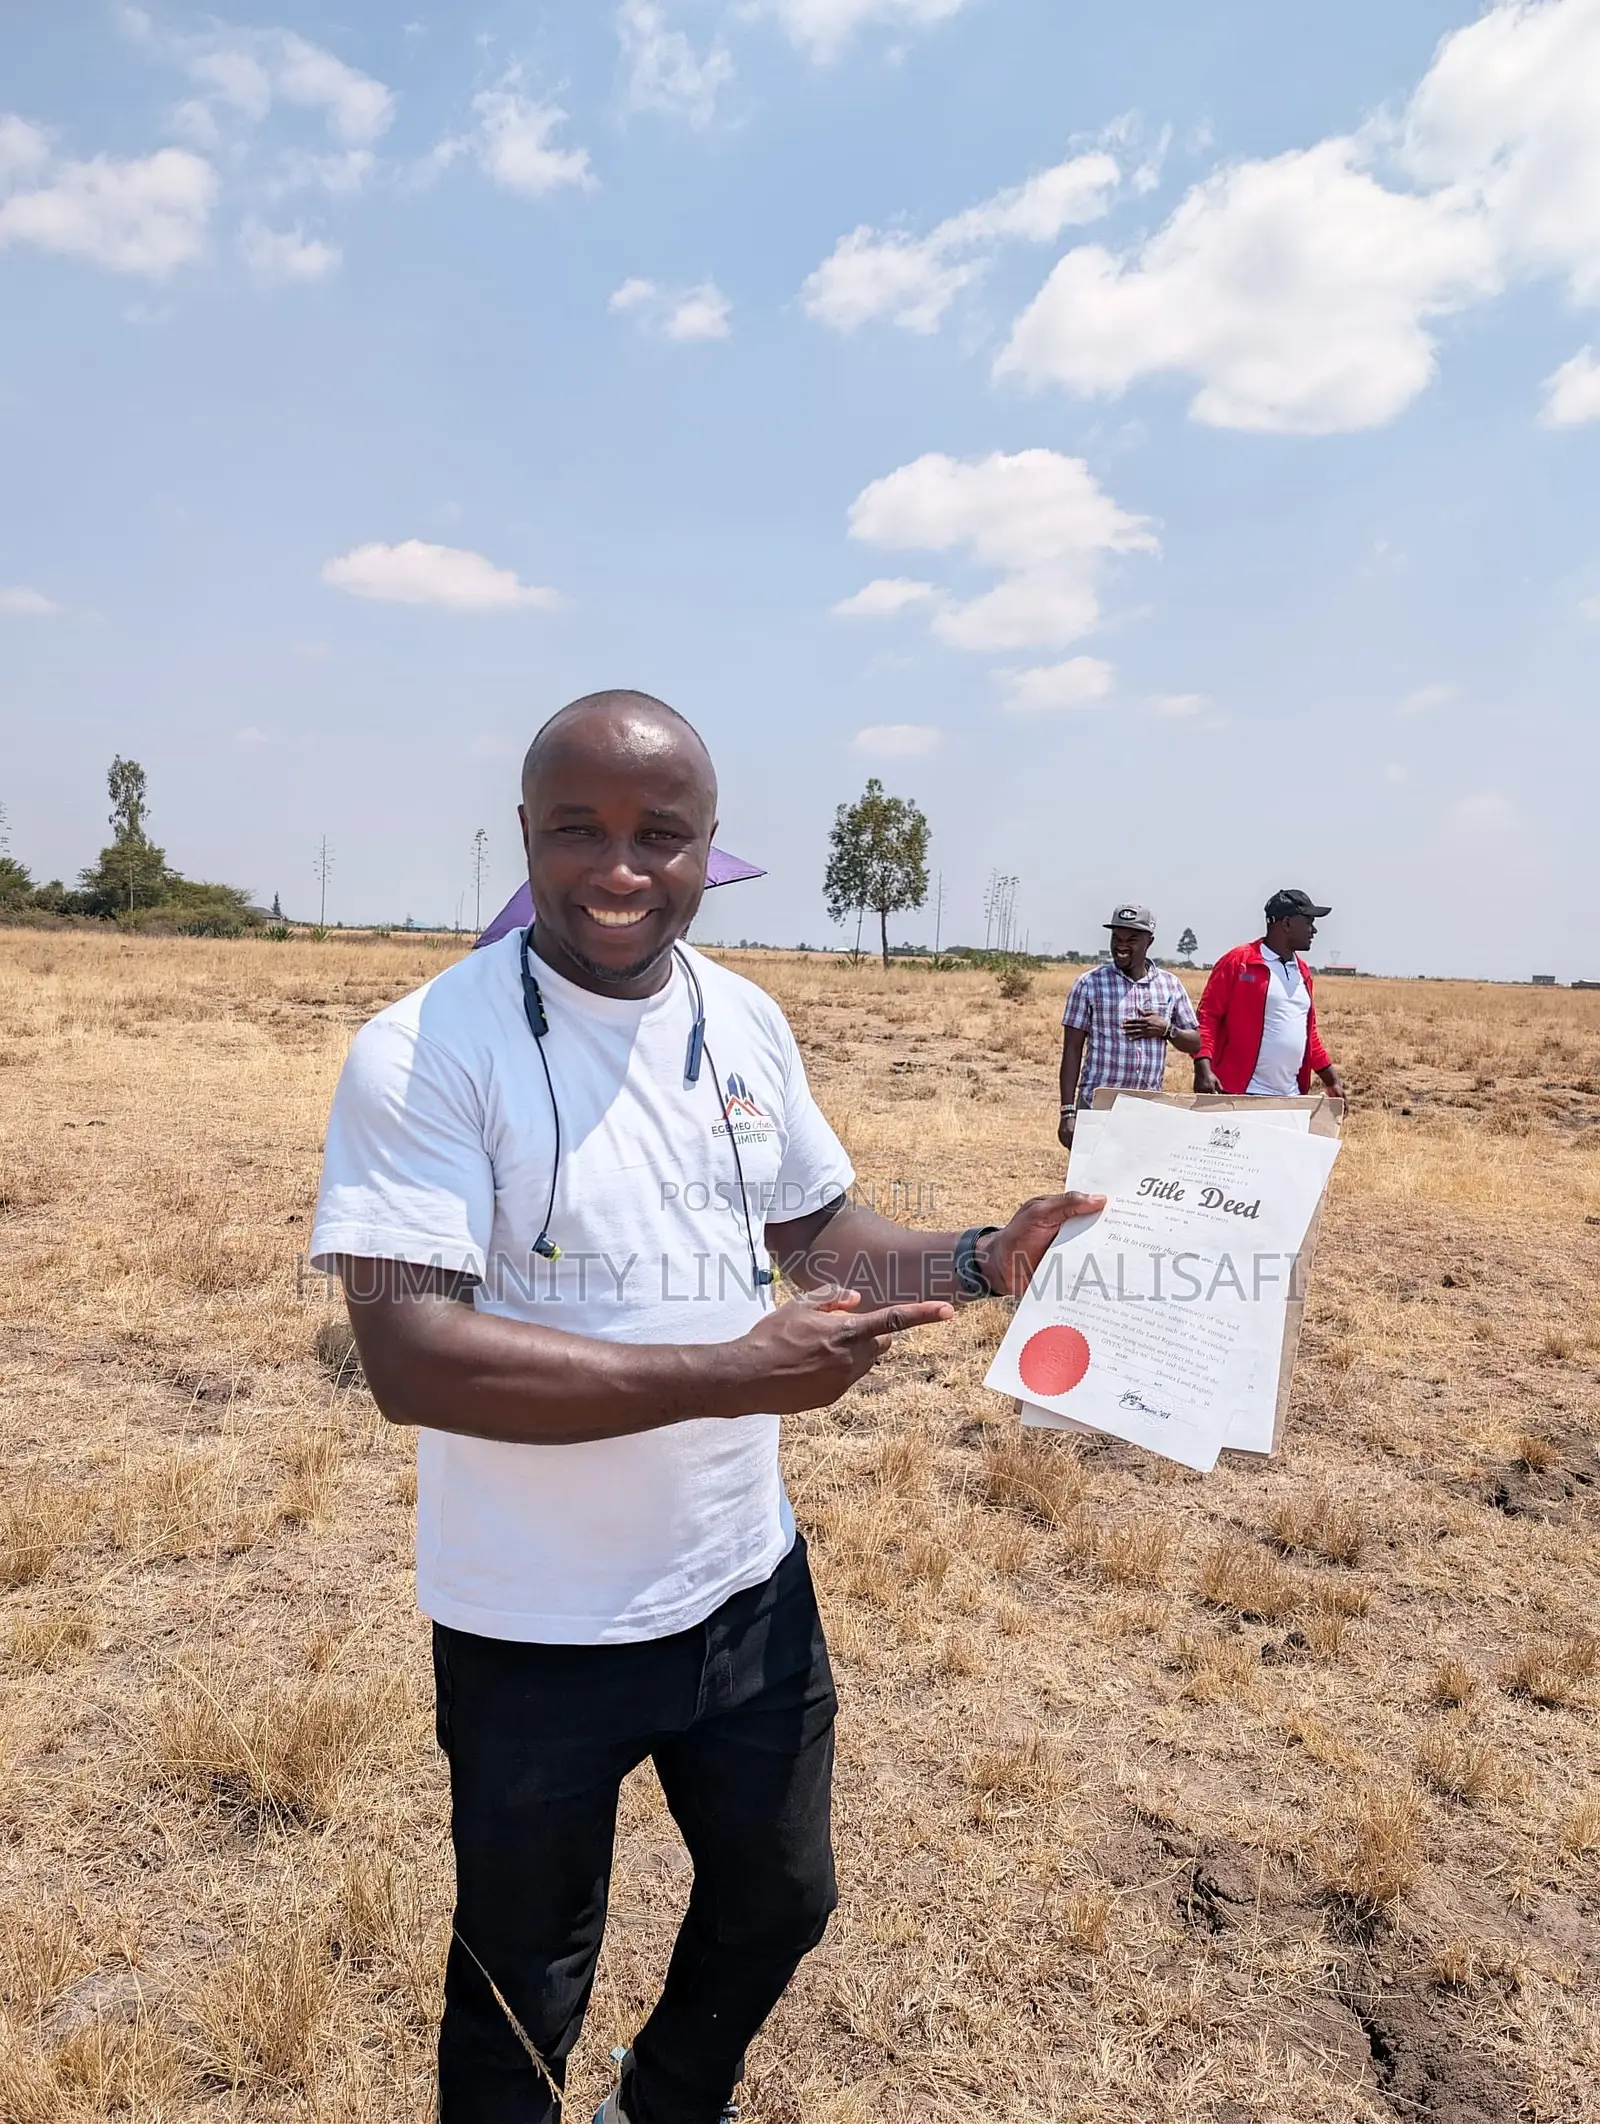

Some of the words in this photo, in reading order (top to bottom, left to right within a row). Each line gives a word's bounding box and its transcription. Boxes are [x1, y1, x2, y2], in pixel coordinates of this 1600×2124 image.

[1136, 1177, 1185, 1201] Title
[1198, 1187, 1261, 1219] Deed
[1108, 1233, 1121, 1241] This
[1139, 1242, 1162, 1252] certify
[1164, 1248, 1178, 1256] that
